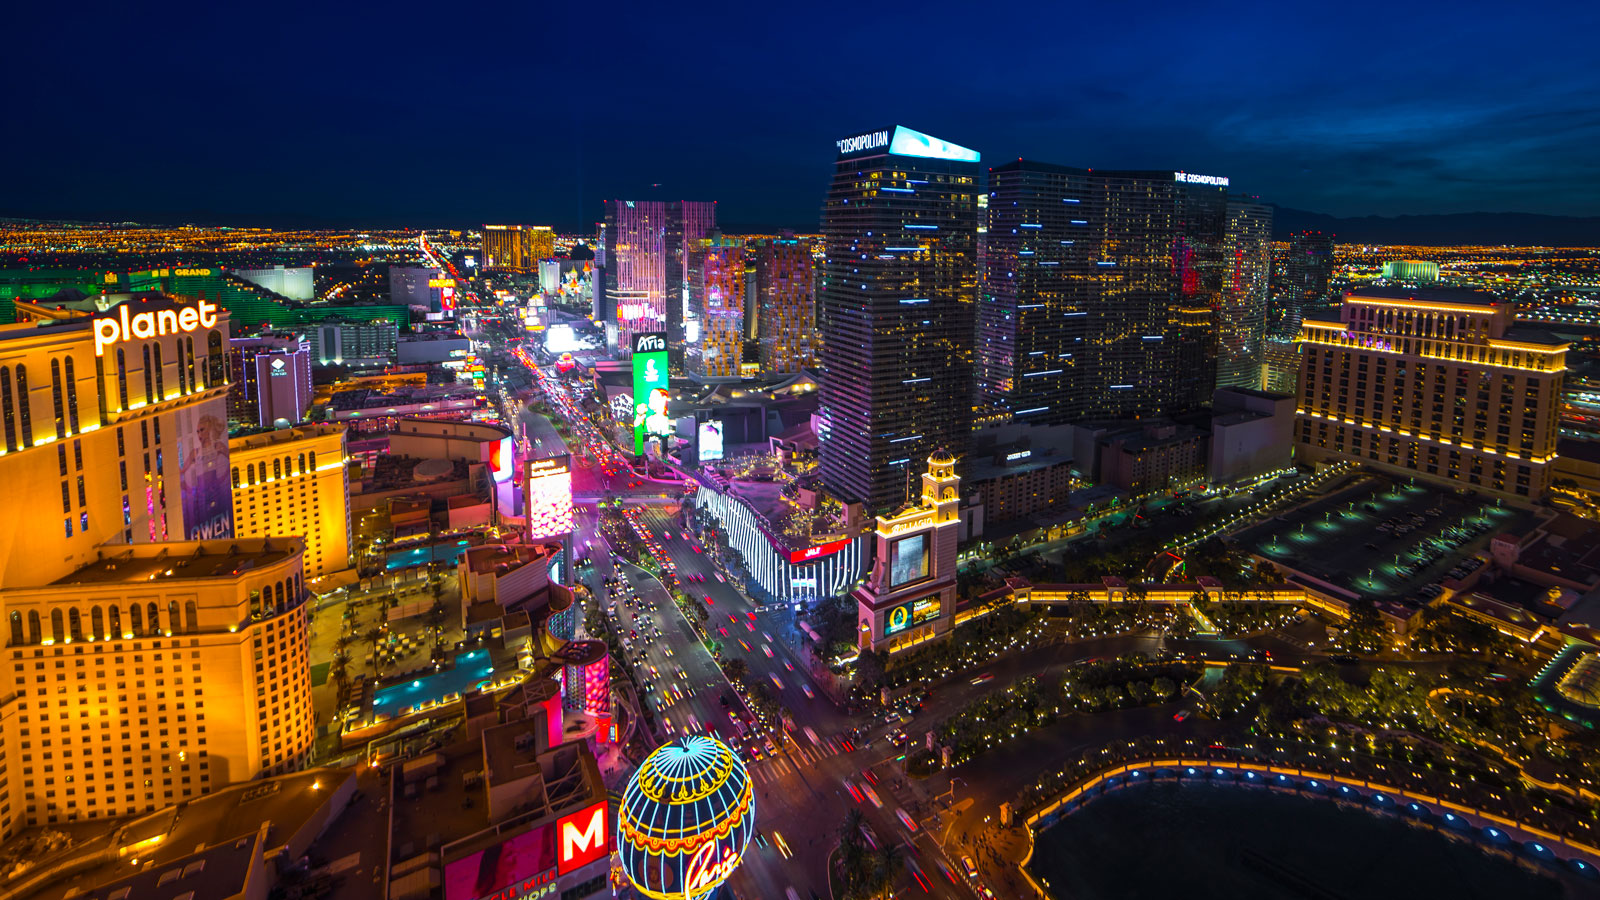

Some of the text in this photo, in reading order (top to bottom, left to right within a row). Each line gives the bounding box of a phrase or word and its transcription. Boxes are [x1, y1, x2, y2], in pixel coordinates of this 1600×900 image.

[841, 130, 888, 154] COSMOPOLITAN
[1174, 171, 1230, 186] THE COSMOPOLITAN
[174, 268, 211, 276] GRAND
[428, 278, 456, 288] MGM
[92, 299, 218, 358] planet
[637, 335, 666, 352] Aria
[891, 517, 933, 535] BELLAGIO
[889, 605, 908, 628] O
[562, 807, 604, 862] M
[523, 869, 556, 891] MILE
[684, 839, 739, 900] Paris
